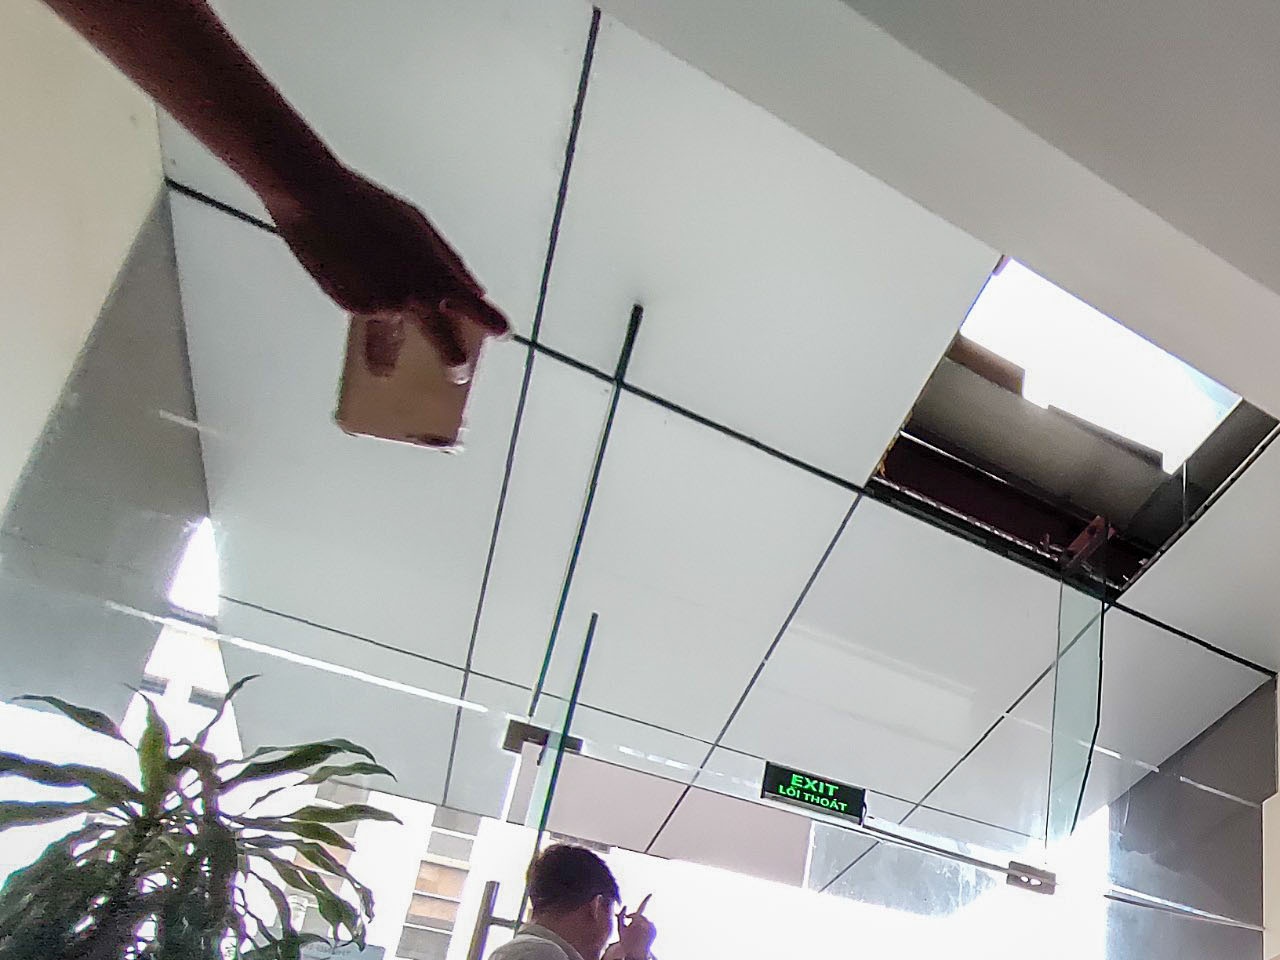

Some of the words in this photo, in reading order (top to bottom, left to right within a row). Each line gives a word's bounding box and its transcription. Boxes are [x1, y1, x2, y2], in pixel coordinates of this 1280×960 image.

[791, 773, 839, 796] EXIT
[778, 784, 800, 798] LỐI
[803, 792, 848, 811] THOÁT
